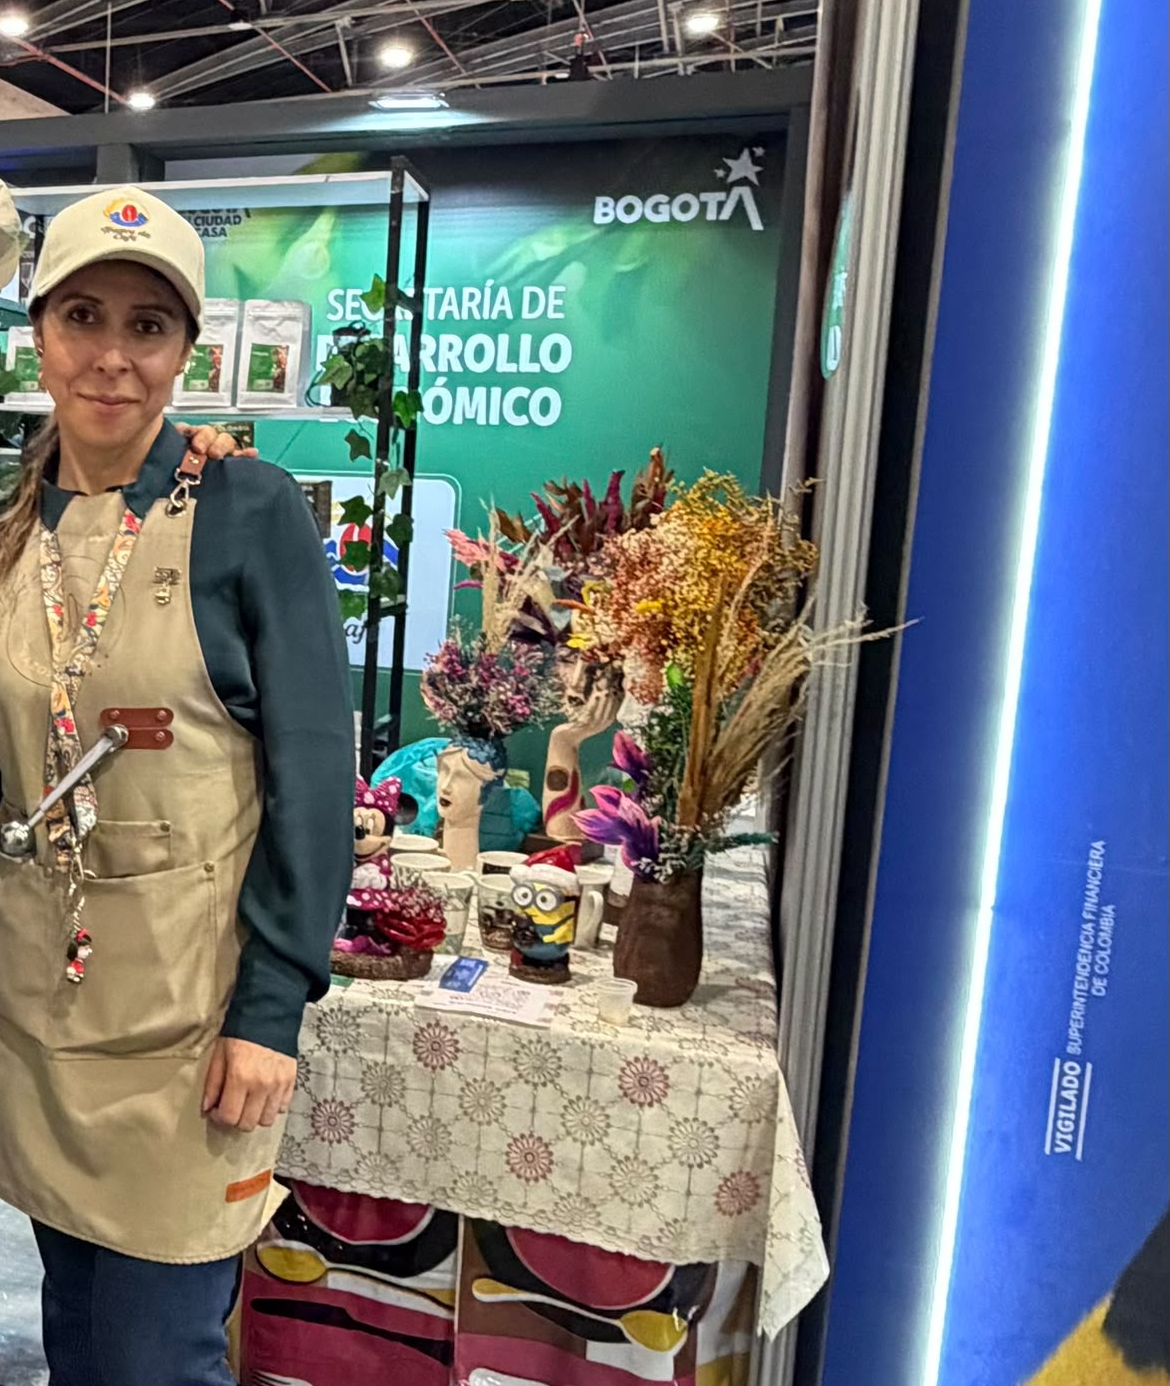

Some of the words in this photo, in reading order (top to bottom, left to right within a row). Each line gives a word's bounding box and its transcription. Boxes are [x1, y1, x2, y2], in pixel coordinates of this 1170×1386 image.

[194, 215, 242, 227] CIUDAD
[326, 279, 514, 322] SETARÍA
[521, 285, 567, 320] DE
[315, 332, 573, 374] ARROLLO
[1082, 840, 1106, 920] FINANCIERA
[1093, 904, 1117, 975] COLOMBIA
[1066, 922, 1096, 1055] SUPERINTENDENCIA
[1090, 976, 1108, 997] DE
[1053, 1061, 1081, 1154] VIGILADO
